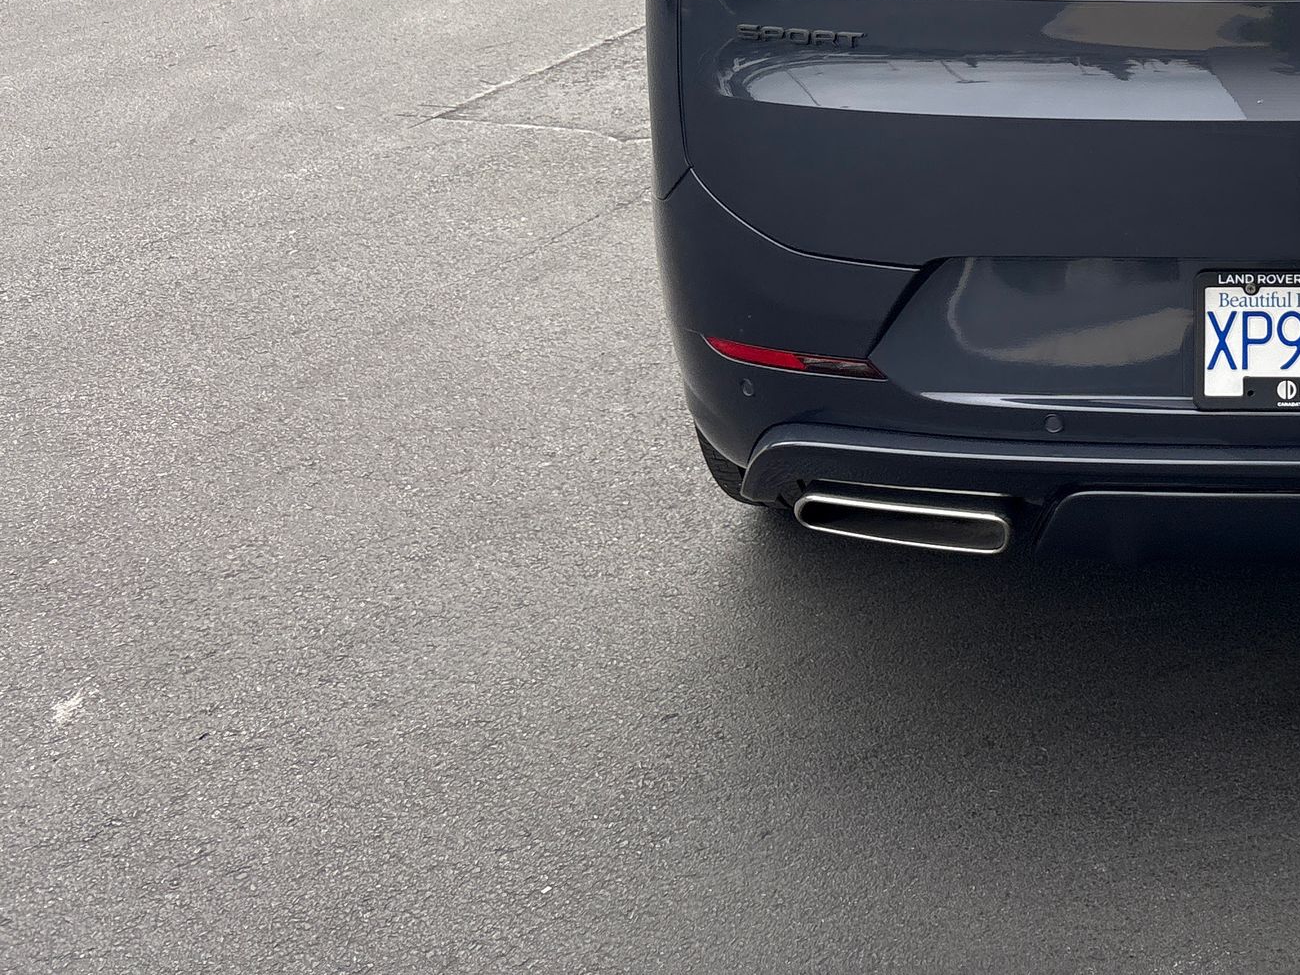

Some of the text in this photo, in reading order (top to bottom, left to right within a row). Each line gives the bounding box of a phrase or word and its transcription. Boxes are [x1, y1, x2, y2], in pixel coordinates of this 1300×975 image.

[736, 23, 865, 49] SPORT
[1218, 274, 1254, 285] LAND
[1219, 292, 1292, 308] Beautiful
